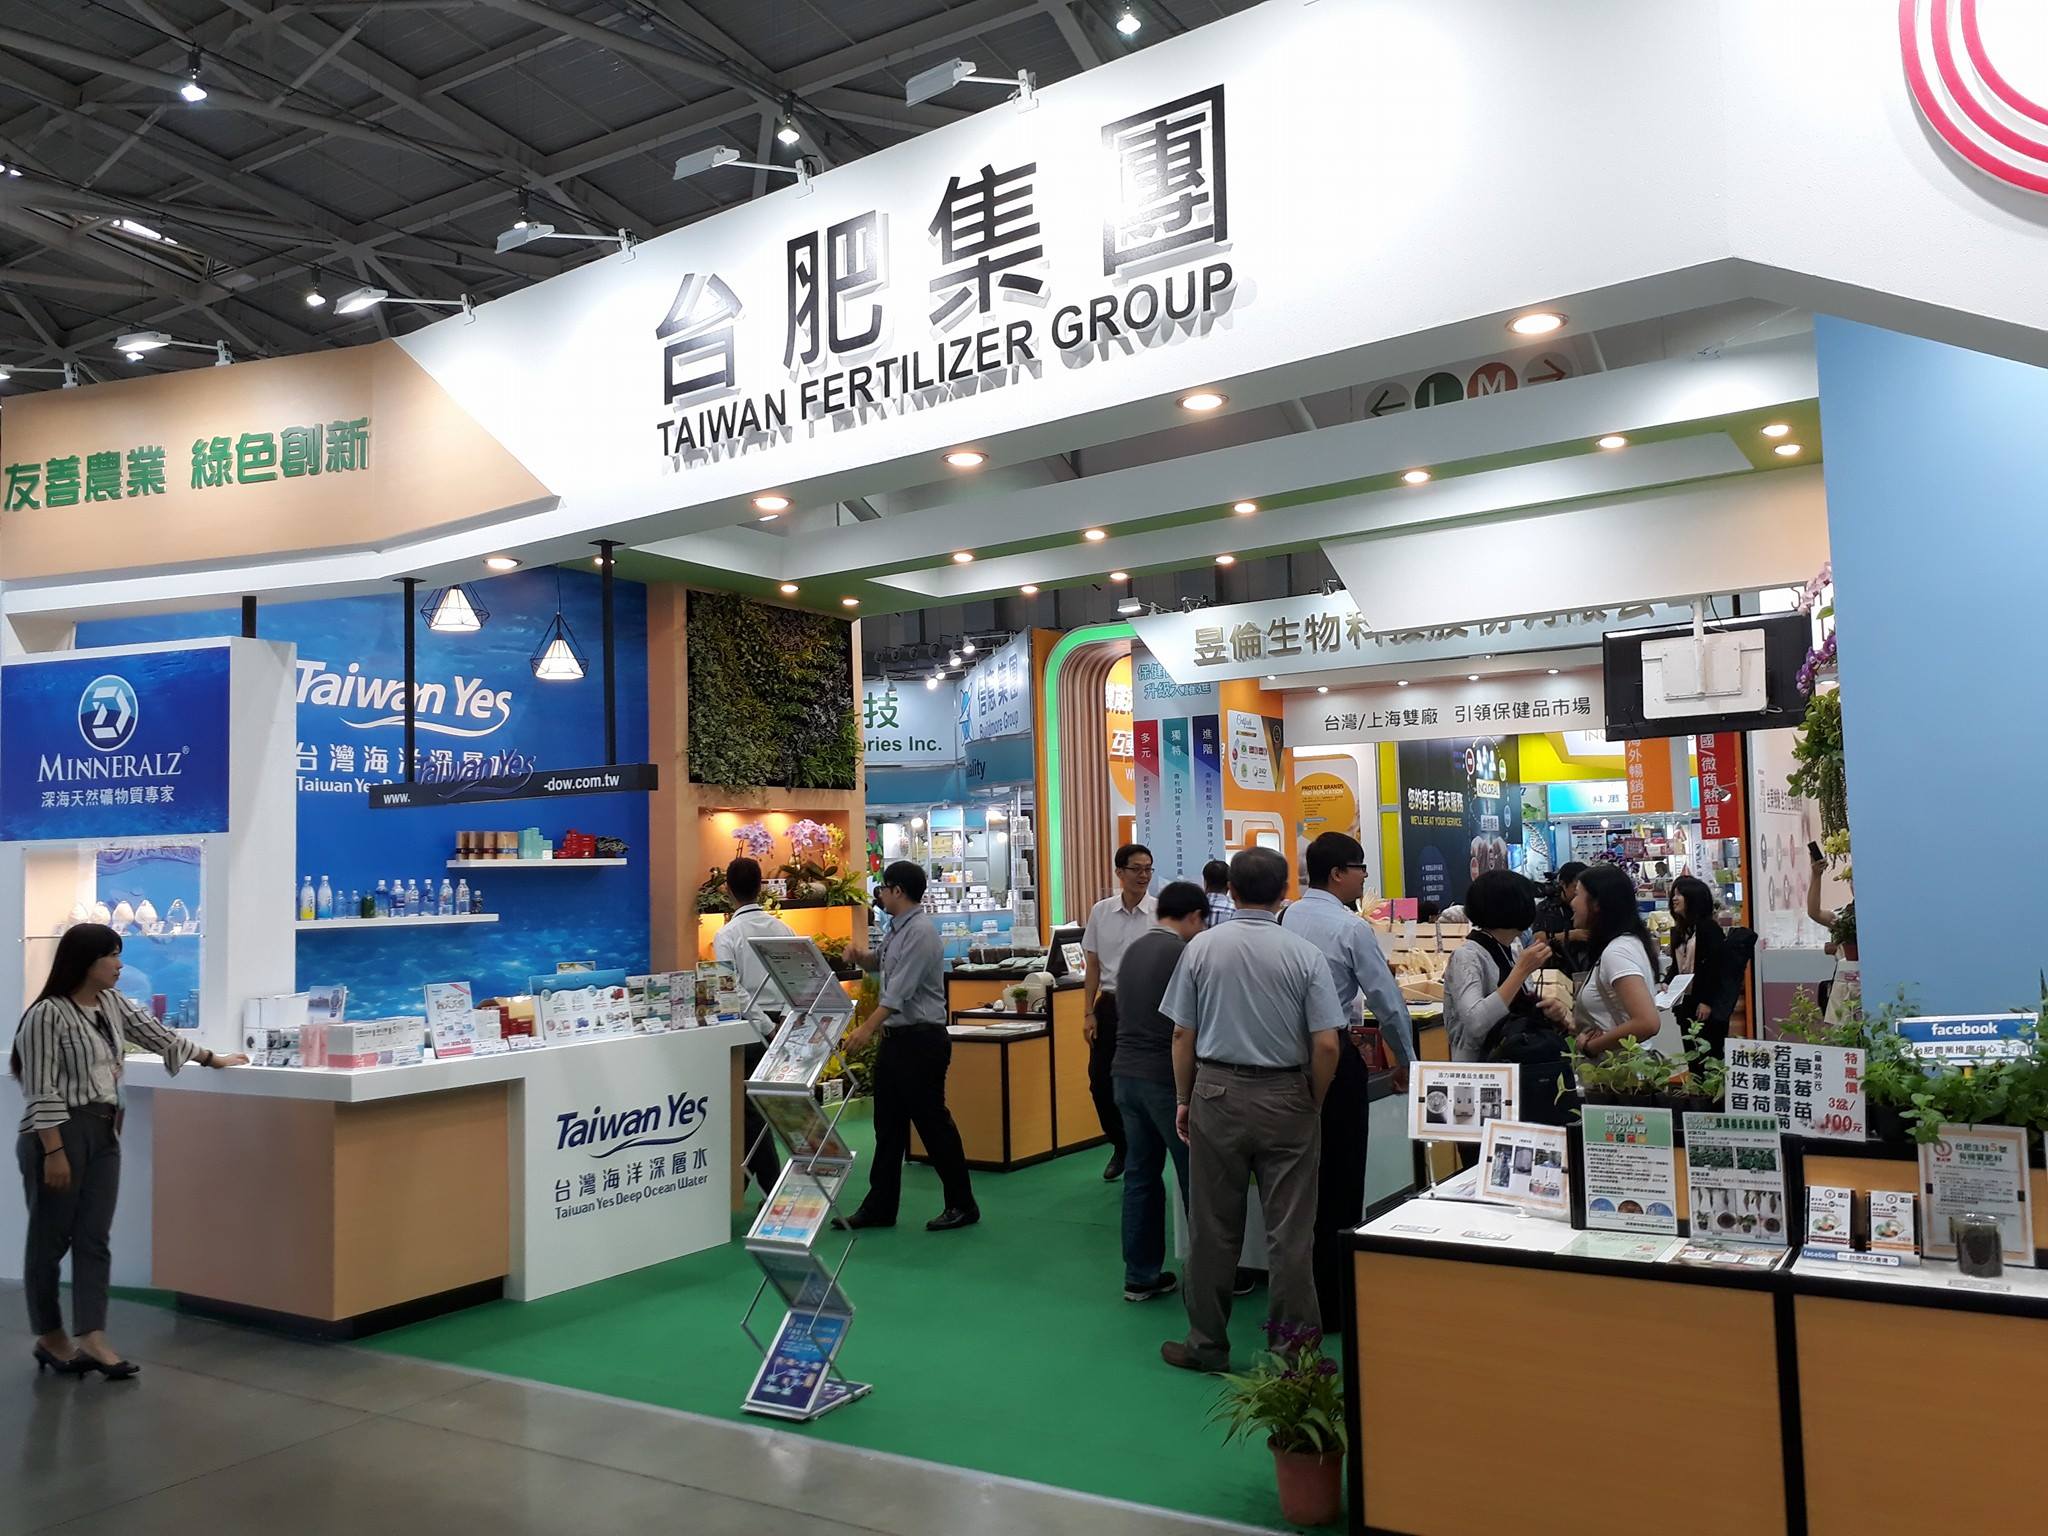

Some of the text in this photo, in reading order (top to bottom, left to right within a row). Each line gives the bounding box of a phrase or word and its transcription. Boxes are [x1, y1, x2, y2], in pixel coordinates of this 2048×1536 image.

[656, 84, 1228, 405] 台肥集團
[657, 261, 1234, 456] TAIWAN FERTILIZER GROUP
[1477, 370, 1506, 397] M
[4, 416, 372, 512] 友善農業 綠色創新
[296, 659, 513, 720] Taiwan Yes
[1137, 663, 1170, 682] 保健
[863, 691, 900, 729] 技
[1004, 710, 1019, 730] Group
[1324, 697, 1591, 732] 台灣/上海雙廠 引領保健品市場
[909, 736, 943, 752] Inc.
[1140, 732, 1151, 759] 多元
[1202, 728, 1213, 755] 進階
[41, 784, 175, 808] 深海天然礦物質專家
[296, 776, 353, 792] Taiwan
[383, 792, 411, 805] www.
[498, 748, 537, 779] Yes
[543, 773, 621, 792] -dow.com.tw
[1931, 1022, 1999, 1036] facebook
[1731, 1049, 1749, 1111] 迷迭香
[1752, 1050, 1770, 1113] 綠薄荷
[1794, 1057, 1812, 1121] 草莓苗
[1844, 1052, 1858, 1095] 特惠價
[556, 1091, 709, 1150] Taiwan Yes
[554, 1147, 708, 1203] 台灣海洋深層水
[554, 1174, 709, 1220] Taiwan Yes Deep Ocean Water
[1803, 1250, 1836, 1259] facebook
